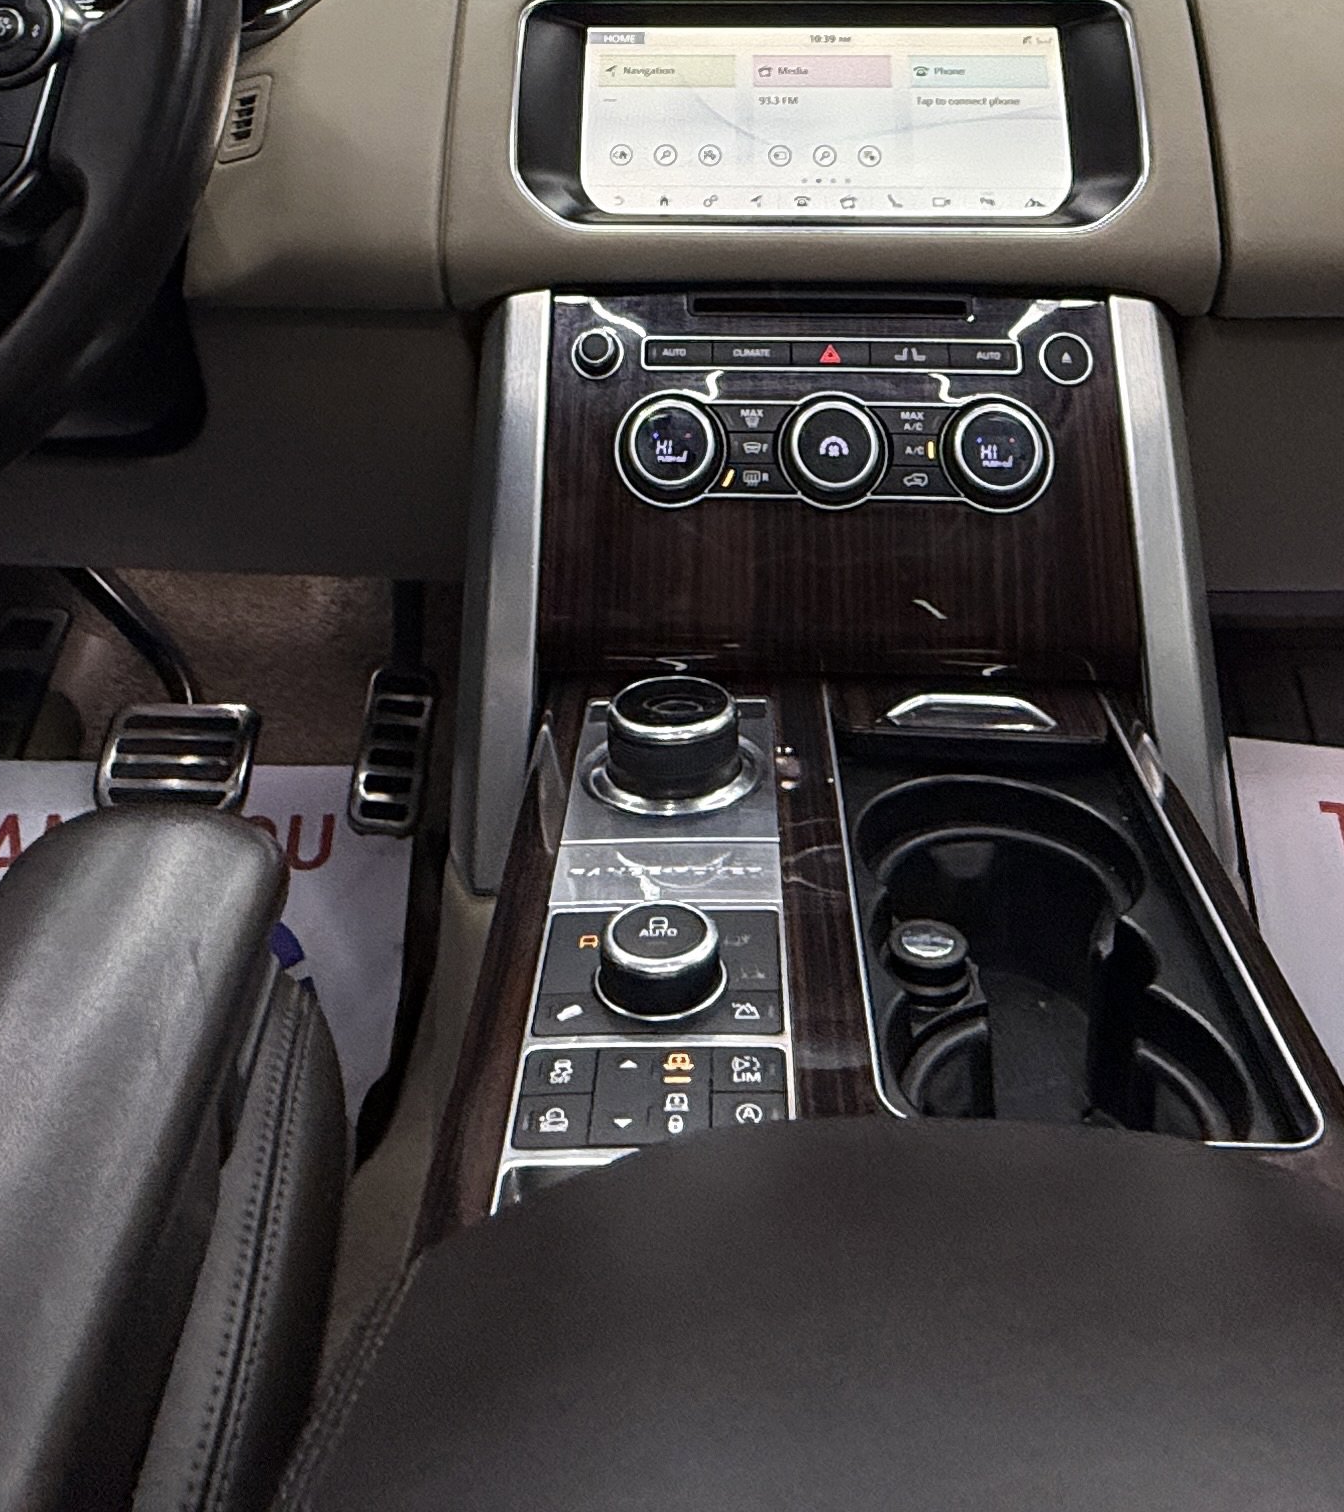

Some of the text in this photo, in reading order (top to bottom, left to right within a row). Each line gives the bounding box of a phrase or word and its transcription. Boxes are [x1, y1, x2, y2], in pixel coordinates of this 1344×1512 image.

[603, 34, 636, 43] HOME
[623, 66, 675, 77] Navigation
[778, 66, 808, 75] Media
[934, 66, 966, 76] Phone
[916, 96, 1020, 107] Tap to connect phone
[662, 348, 687, 357] AUTO
[732, 348, 771, 357] CLIMATE
[976, 351, 1001, 360] AUTO
[740, 408, 764, 417] MAX
[900, 411, 925, 420] MAX
[903, 423, 924, 431] A/C
[905, 445, 924, 455] A/C
[762, 472, 769, 482] R
[638, 927, 678, 937] AUTO
[733, 1071, 761, 1083] LIM
